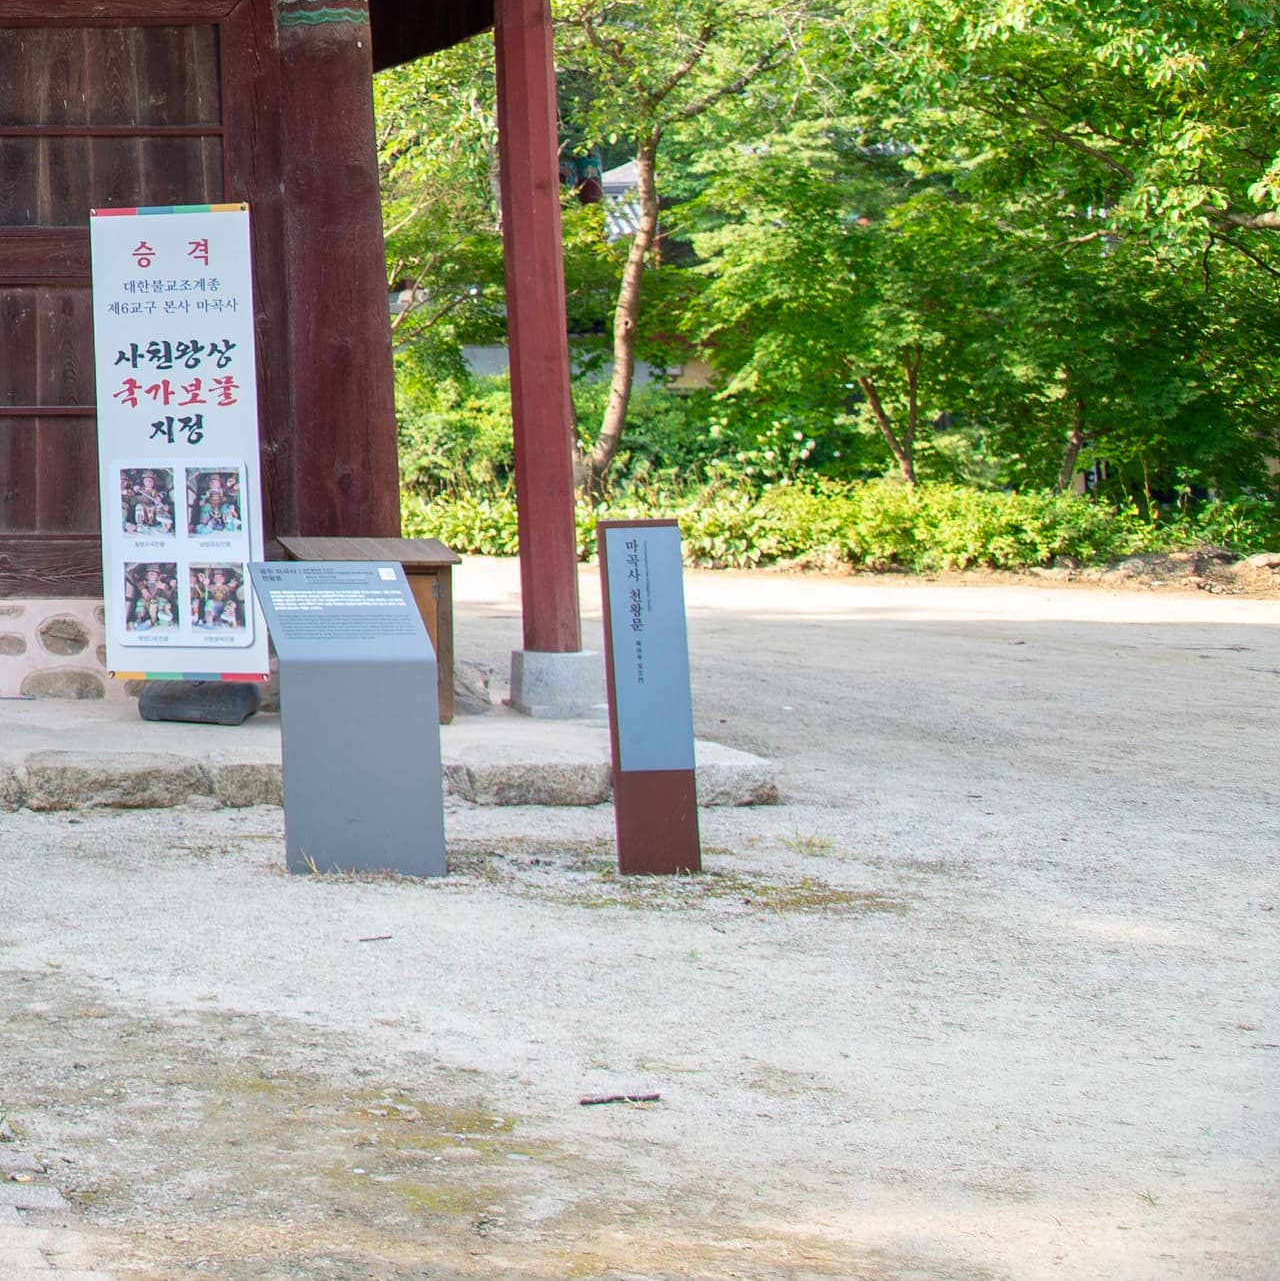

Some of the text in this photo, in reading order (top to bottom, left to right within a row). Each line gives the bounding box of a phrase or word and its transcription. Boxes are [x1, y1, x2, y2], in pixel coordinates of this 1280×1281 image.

[123, 277, 221, 294] 대한불교조계종
[107, 298, 239, 315] 제6교구 본사 마곡사
[113, 339, 237, 370] 사천왕상
[112, 375, 240, 408] 국가보물
[149, 413, 204, 445] 지정
[625, 538, 641, 583] 마곡사
[628, 588, 646, 632] 천왕문
